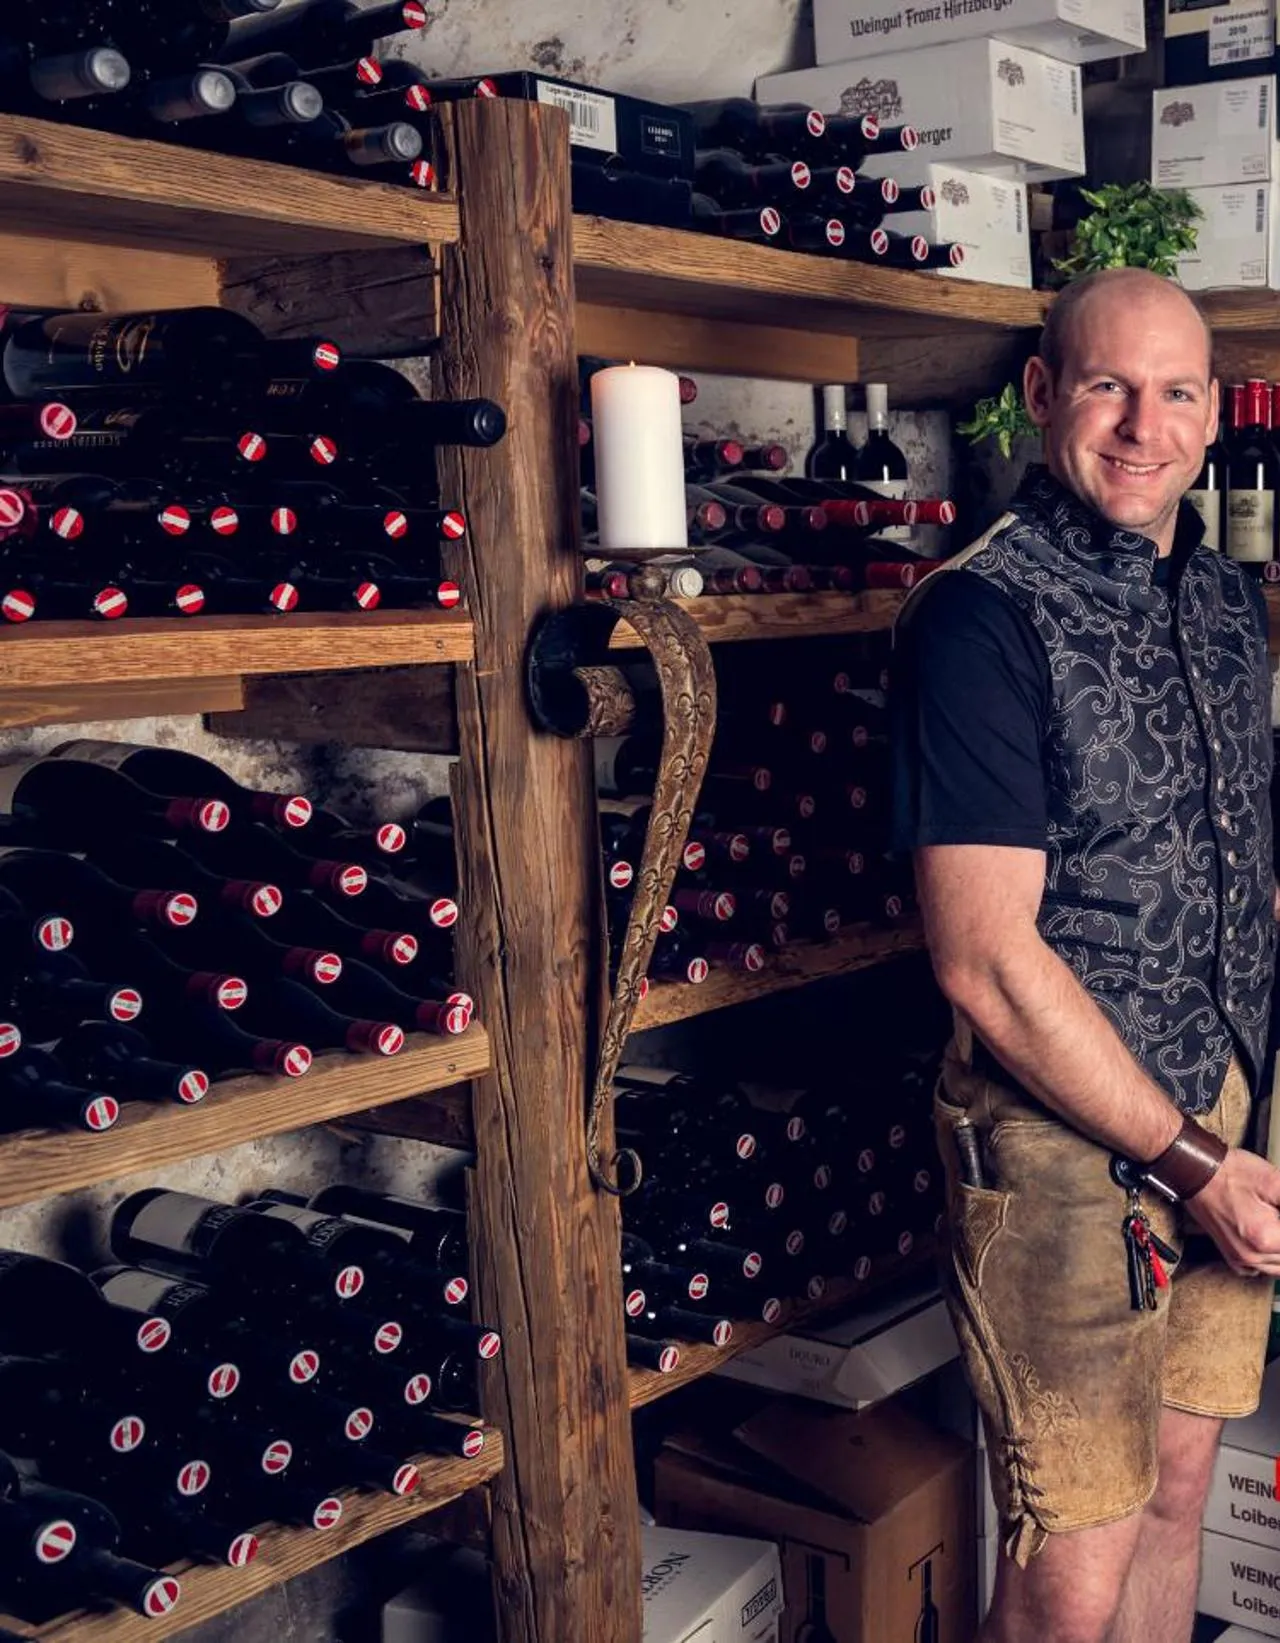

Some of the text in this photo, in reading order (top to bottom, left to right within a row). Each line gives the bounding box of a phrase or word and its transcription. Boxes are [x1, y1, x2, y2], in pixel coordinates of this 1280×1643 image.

[850, 14, 902, 37] Weingut
[906, 5, 941, 29] Franz
[1228, 1473, 1276, 1501] WEIN
